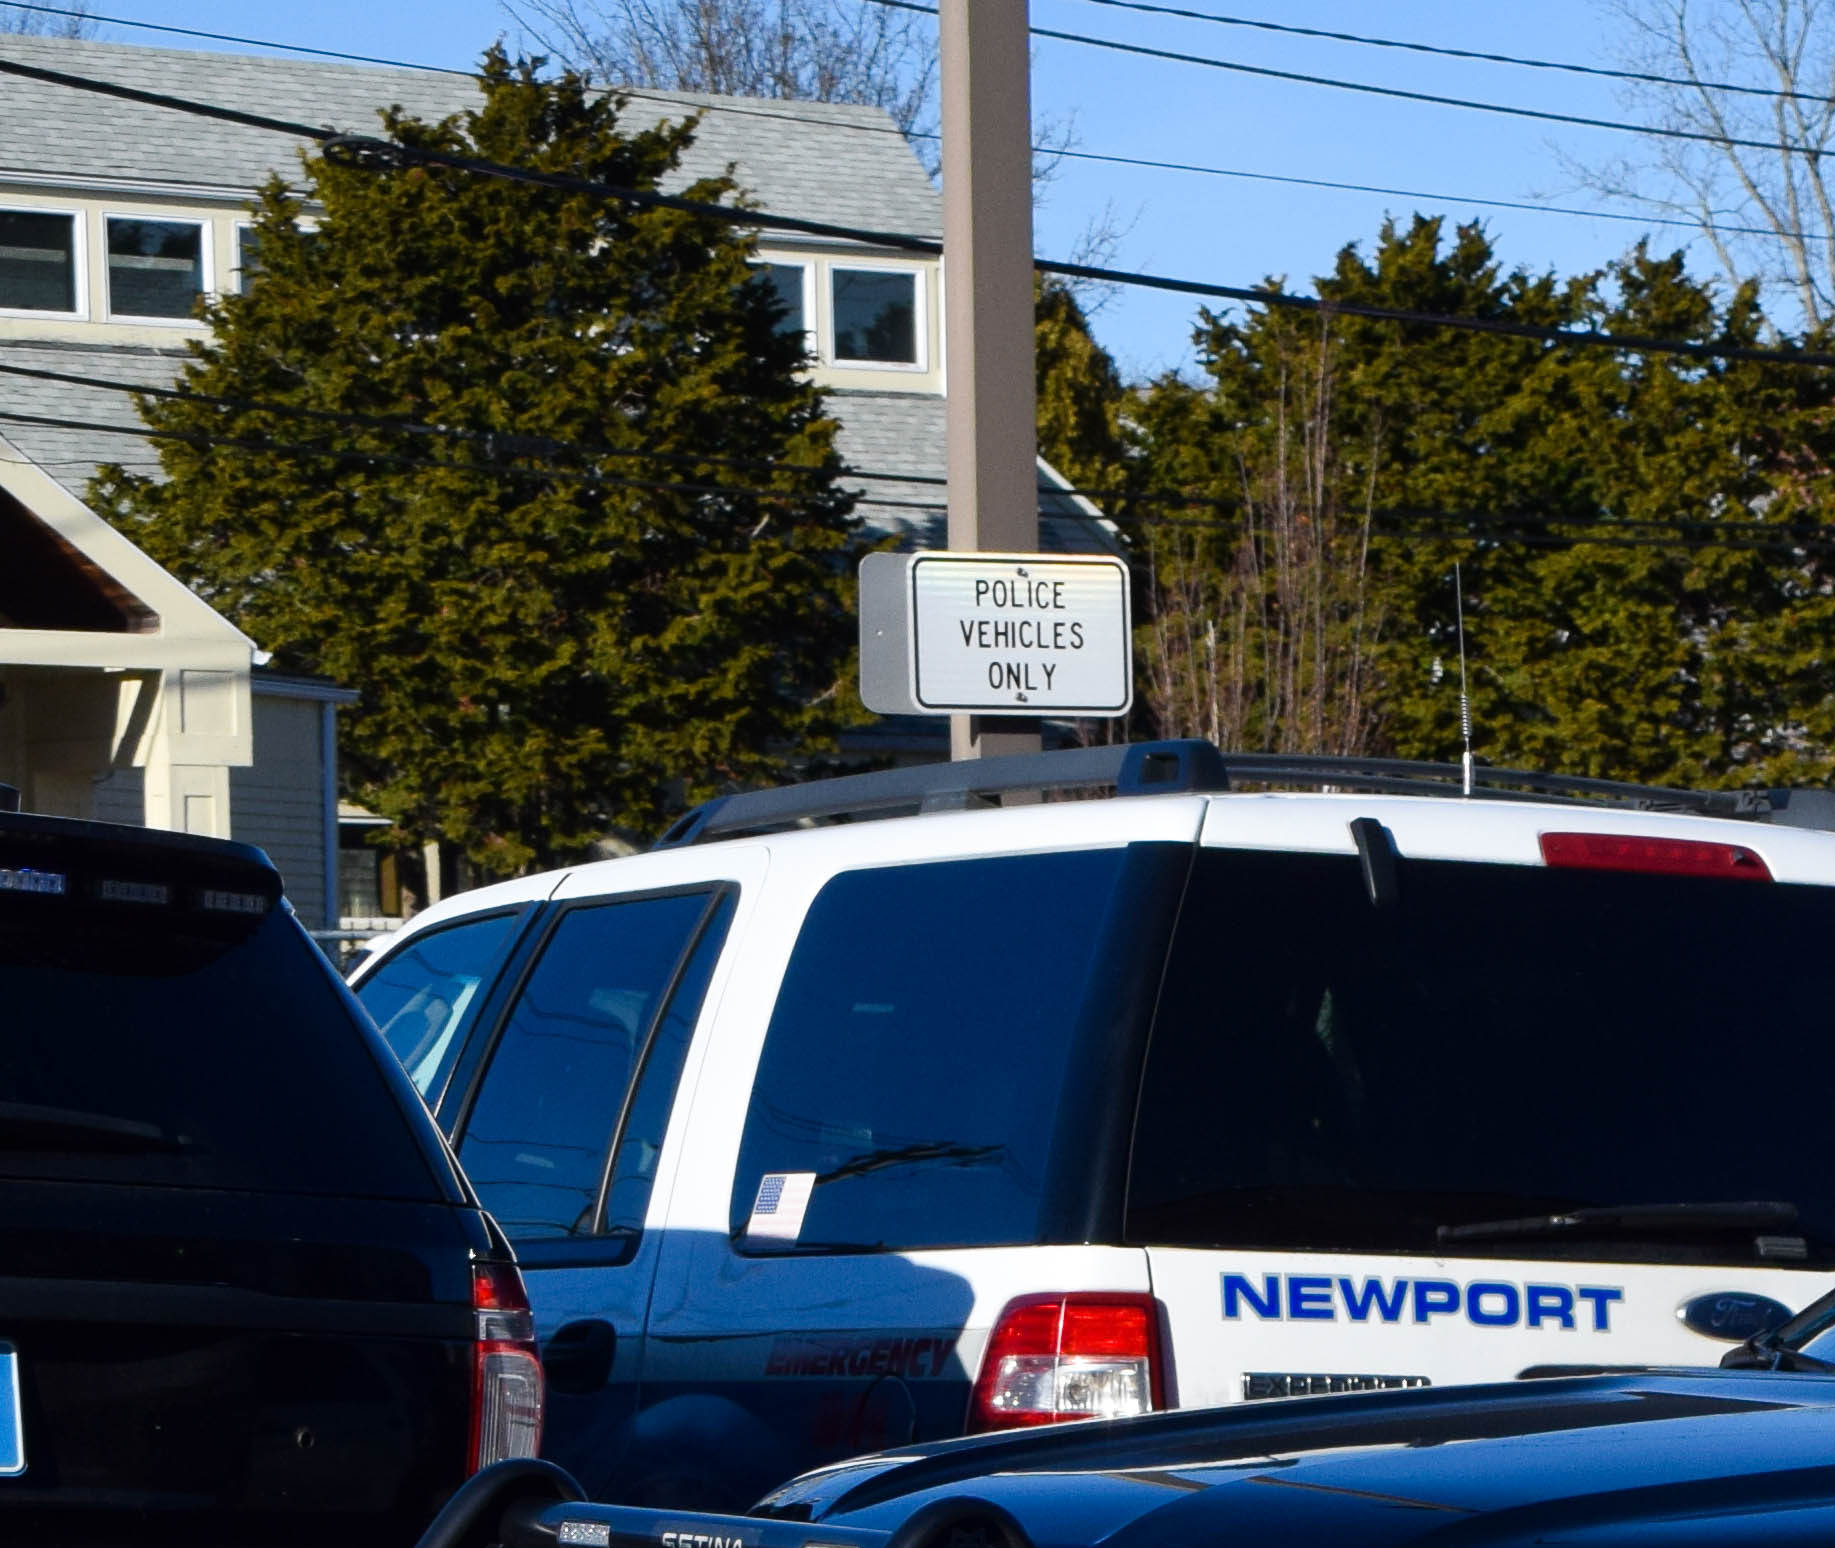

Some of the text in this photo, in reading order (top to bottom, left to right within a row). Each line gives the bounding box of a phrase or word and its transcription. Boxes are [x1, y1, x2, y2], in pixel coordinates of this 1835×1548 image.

[975, 579, 1066, 609] POLICE
[959, 619, 1085, 650] VEHICLES
[988, 661, 1056, 691] ONLY
[1221, 1272, 1625, 1333] NEWPORT
